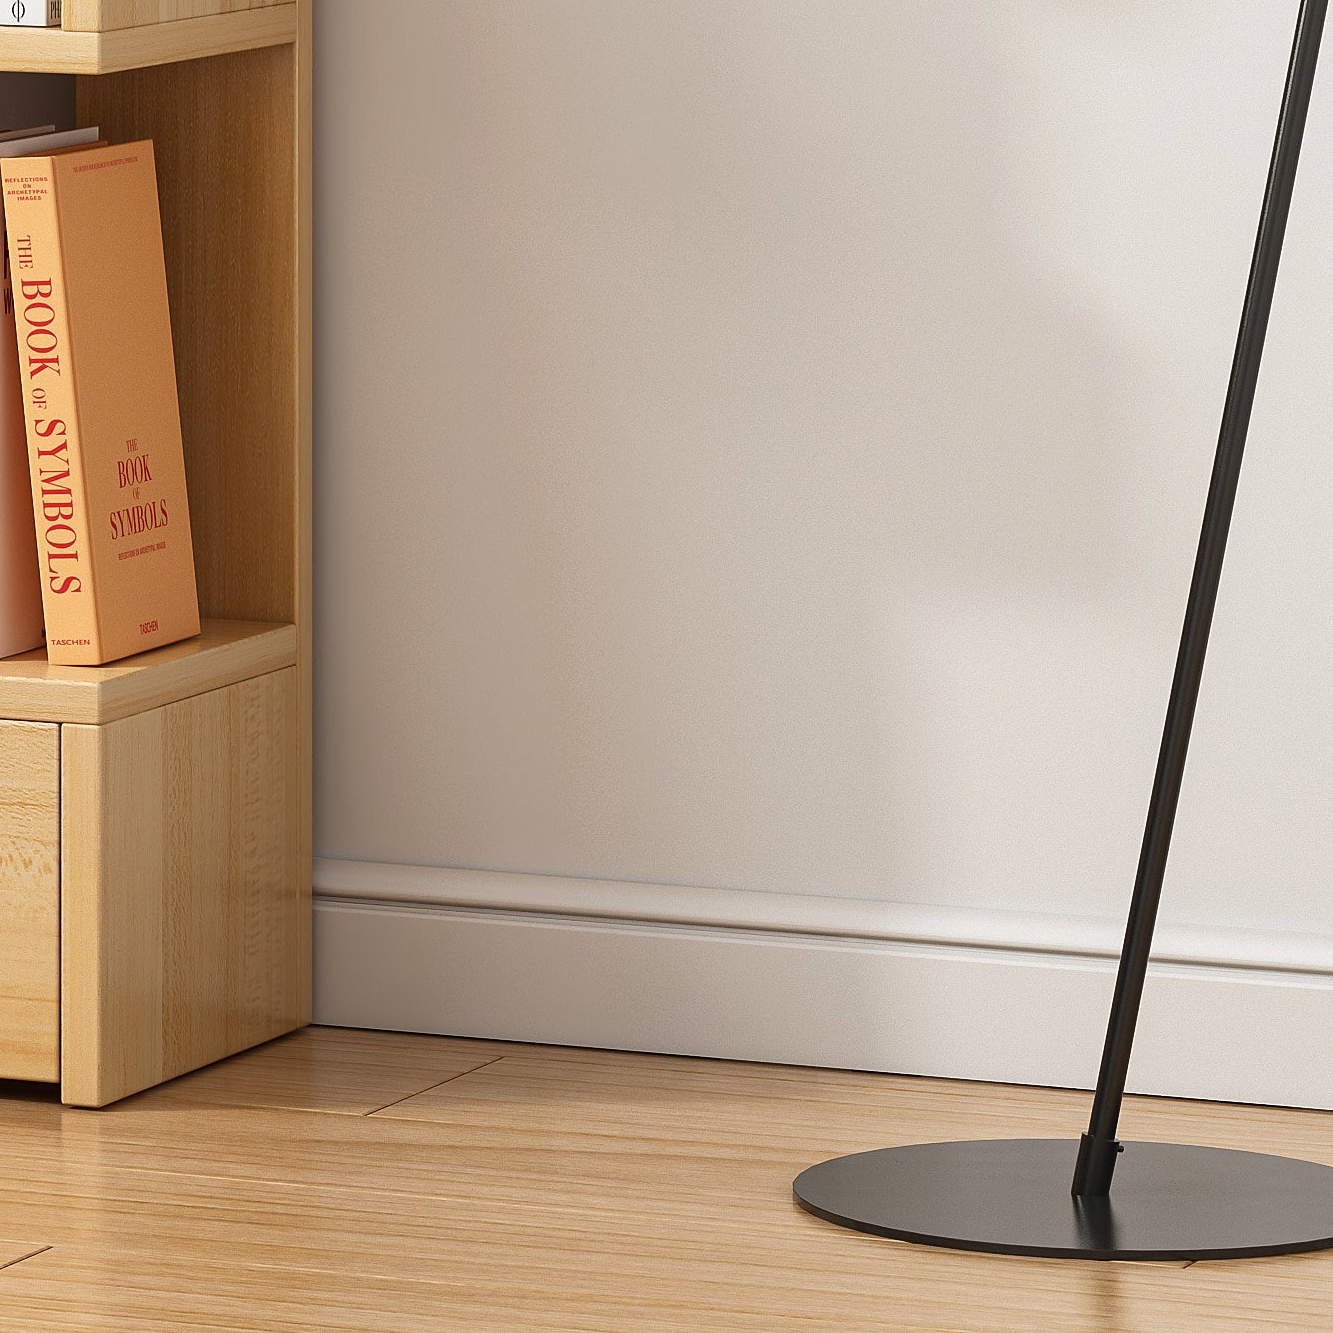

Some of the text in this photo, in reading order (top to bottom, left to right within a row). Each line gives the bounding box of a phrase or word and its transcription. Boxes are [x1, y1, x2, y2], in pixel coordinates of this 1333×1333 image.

[16, 234, 82, 595] THE BOOK OF SYMBOLS
[125, 437, 139, 454] THE
[116, 453, 153, 489] BOOK
[131, 487, 142, 501] OF
[109, 498, 169, 540] SYMBOLS
